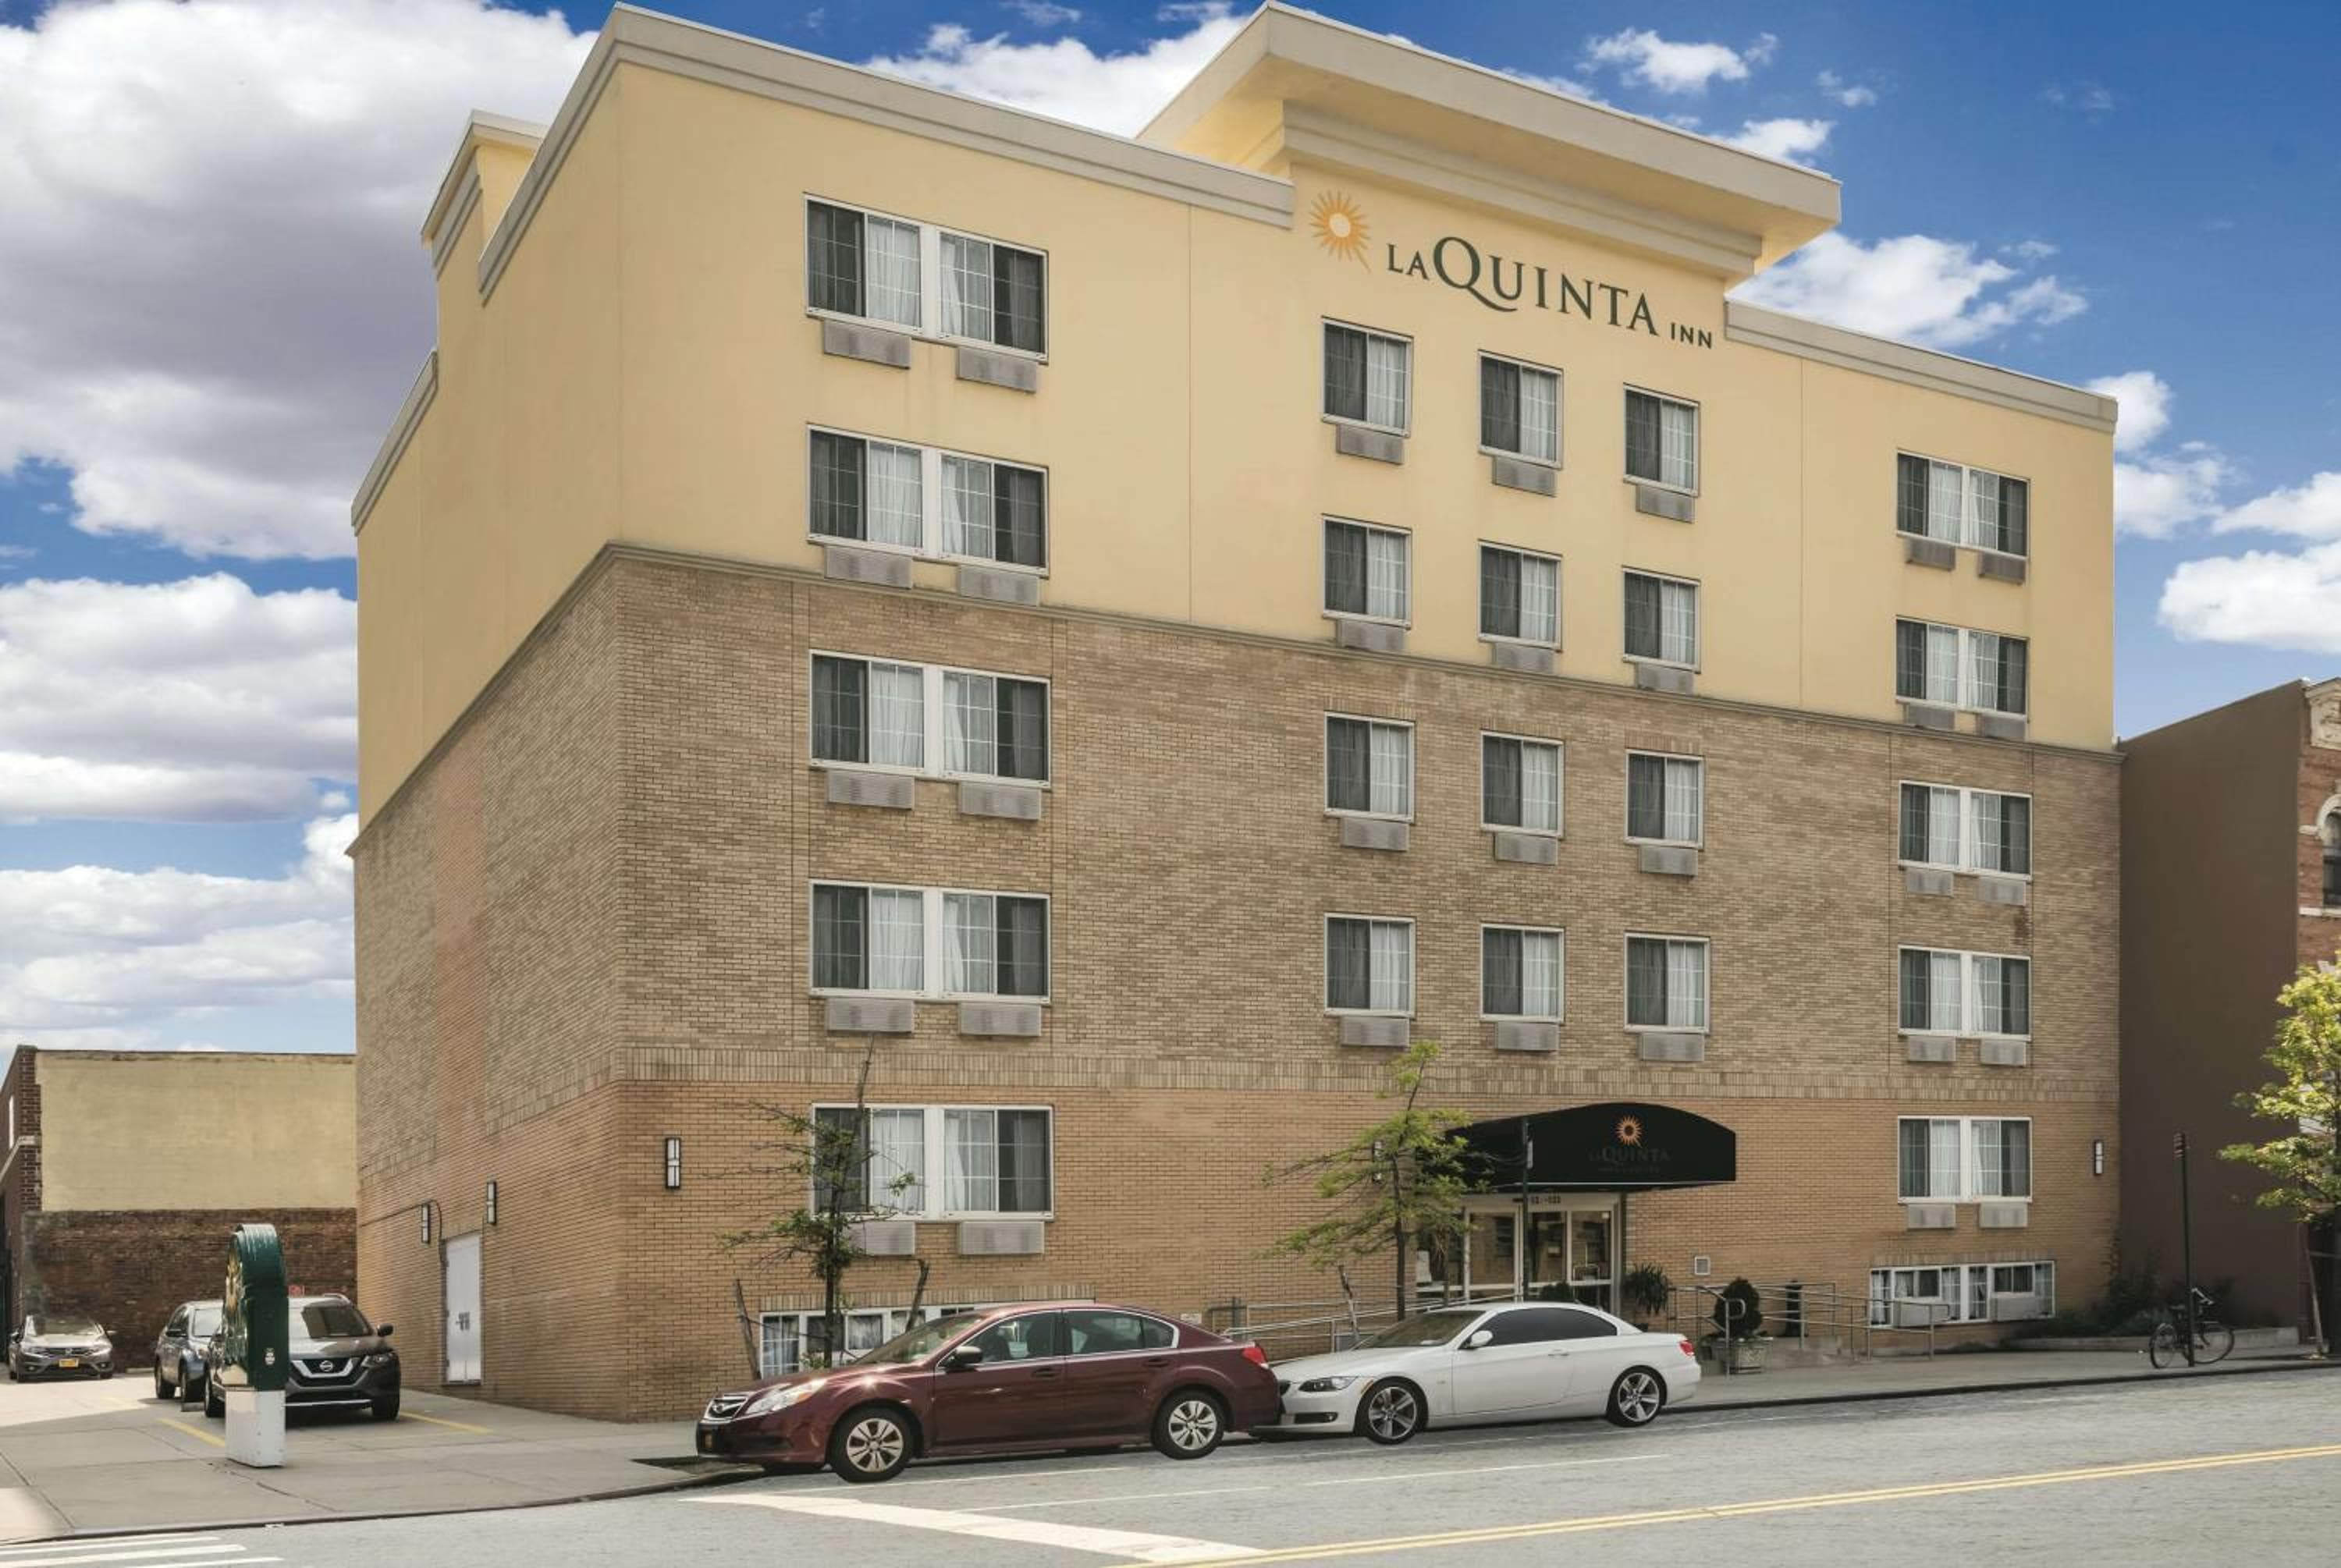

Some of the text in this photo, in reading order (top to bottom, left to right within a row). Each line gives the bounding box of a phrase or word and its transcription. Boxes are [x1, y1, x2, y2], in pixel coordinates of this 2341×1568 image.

[1387, 236, 1714, 349] LA QUINTA INN
[1602, 1148, 1671, 1165] QUINTA
